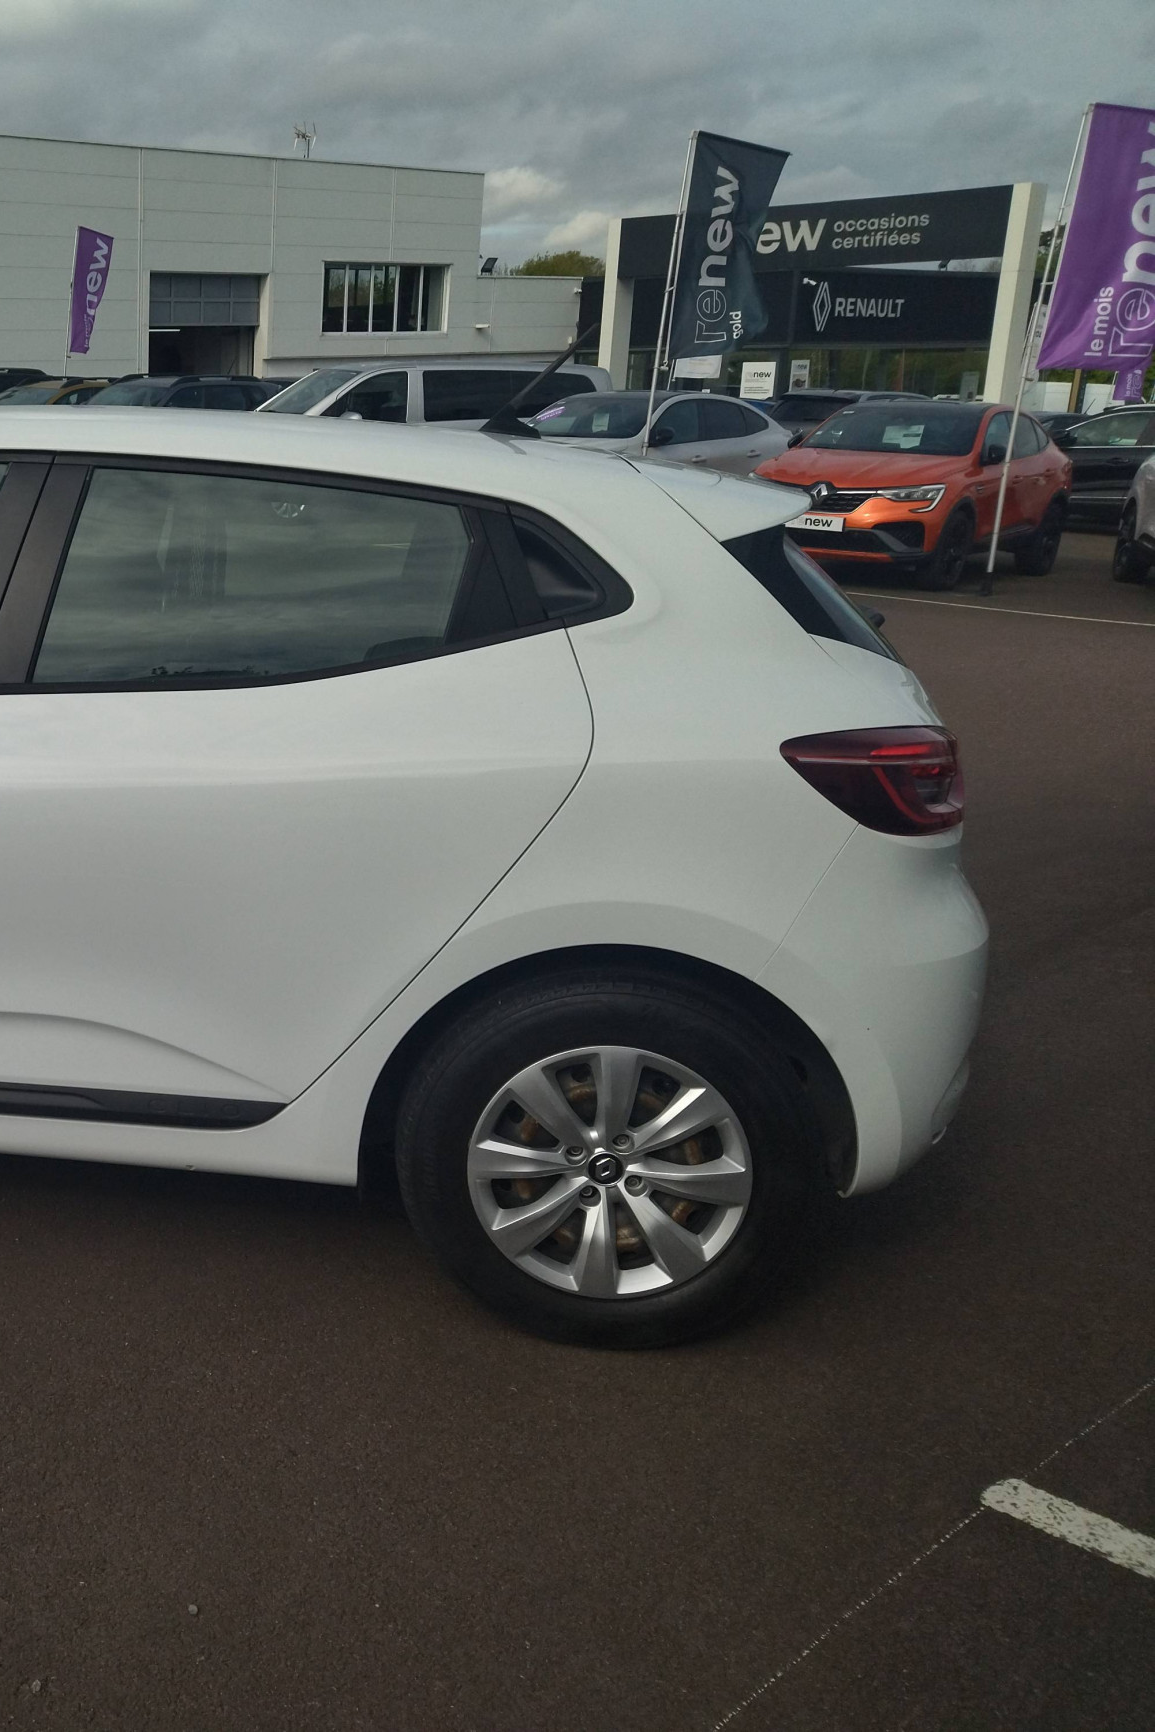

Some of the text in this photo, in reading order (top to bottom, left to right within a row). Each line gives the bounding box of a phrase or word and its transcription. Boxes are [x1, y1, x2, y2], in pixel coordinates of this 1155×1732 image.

[834, 213, 930, 232] occasions
[832, 231, 921, 249] certifiées
[694, 165, 740, 343] renew
[834, 297, 905, 318] RENAULT
[729, 310, 743, 339] gold
[1084, 286, 1115, 357] le mois
